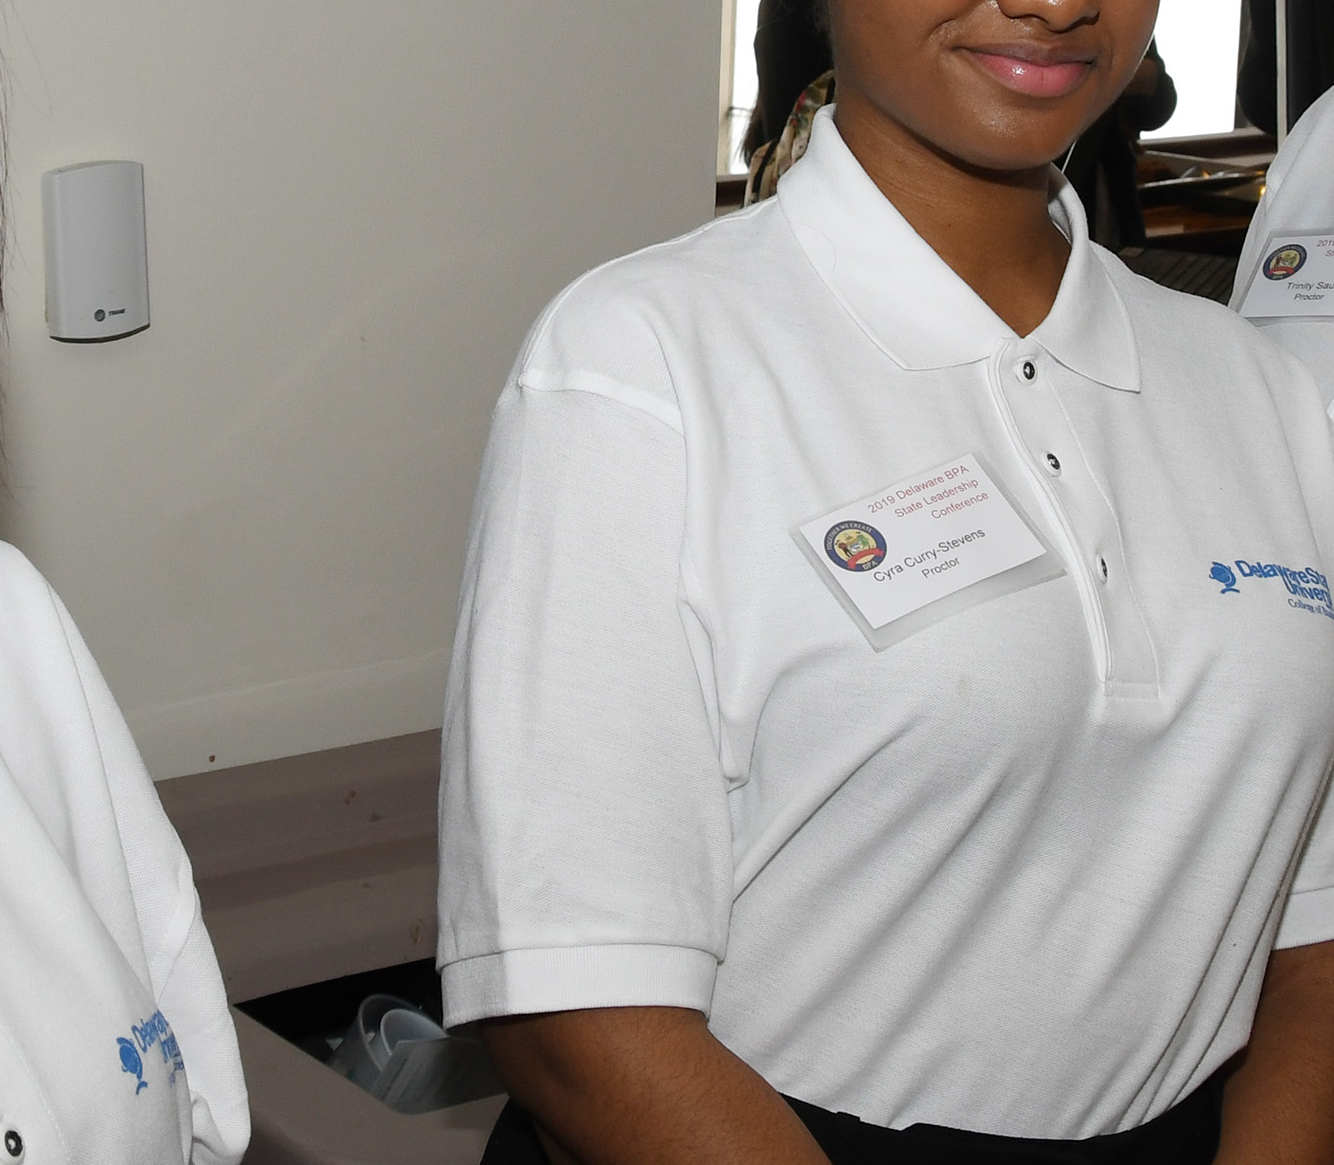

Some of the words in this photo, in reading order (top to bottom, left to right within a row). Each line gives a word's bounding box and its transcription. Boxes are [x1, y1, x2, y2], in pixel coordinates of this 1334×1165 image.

[1287, 281, 1314, 291] Trinity
[1294, 293, 1325, 301] Proctor
[868, 494, 897, 514] 2019
[896, 474, 945, 501] Delaware
[944, 464, 970, 485] BPA
[895, 498, 924, 519] State
[924, 477, 980, 507] Leadership
[930, 490, 989, 520] Conference
[873, 563, 904, 584] Cyra
[904, 527, 987, 569] Curry-Stevens
[921, 555, 961, 579] Proctor
